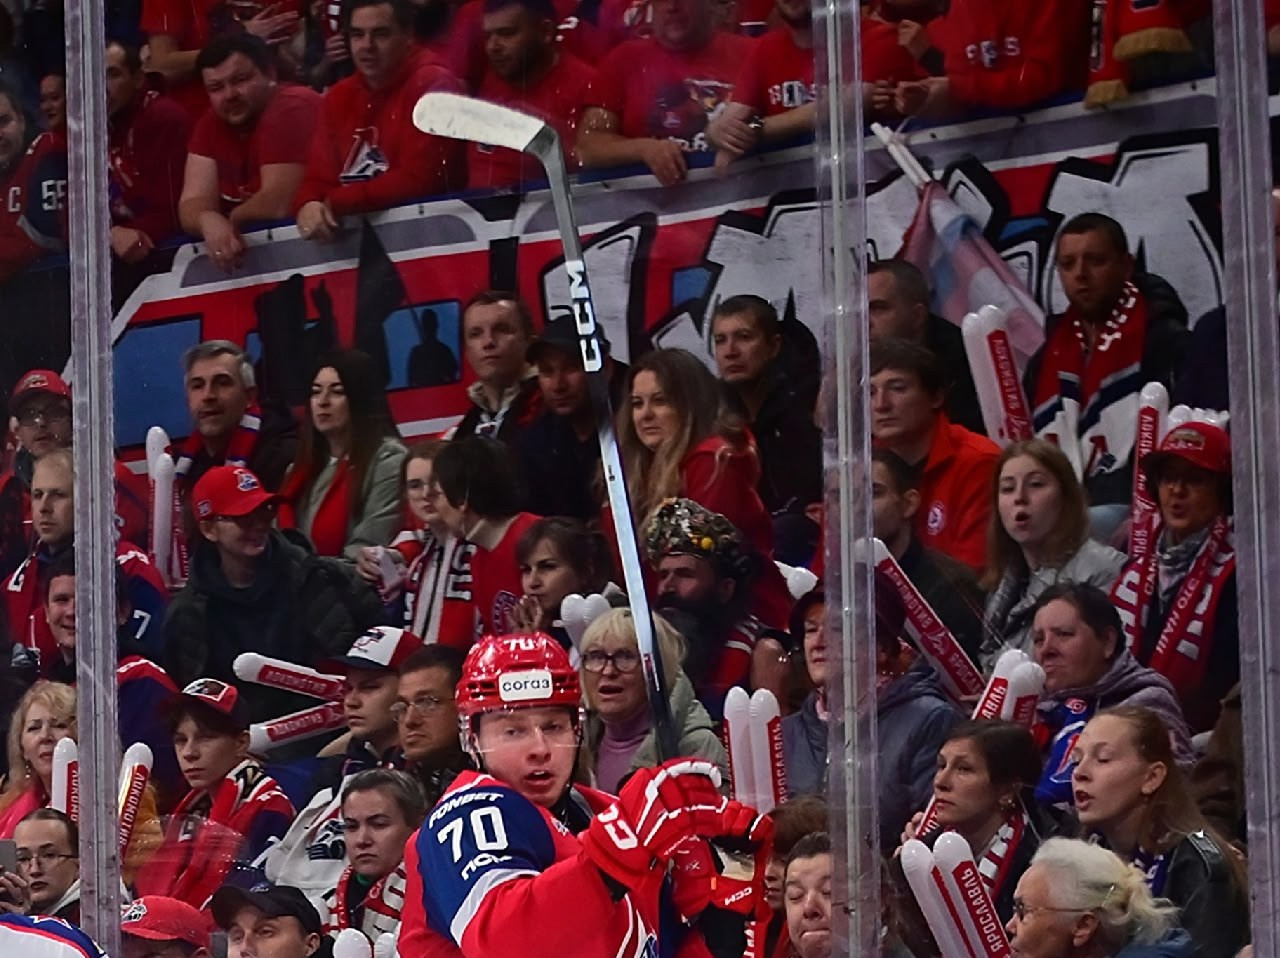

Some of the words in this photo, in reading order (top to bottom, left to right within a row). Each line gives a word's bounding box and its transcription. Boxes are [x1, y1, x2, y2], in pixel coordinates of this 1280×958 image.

[564, 260, 602, 372] CCM
[502, 679, 550, 692] согаз
[948, 653, 985, 694] ЯРОСЛА
[119, 772, 145, 846] ЛОКОМОТИВ
[428, 792, 504, 830] FONBET
[437, 806, 509, 863] 70
[962, 867, 1003, 954] ЯРОСЛАВЛЬ
